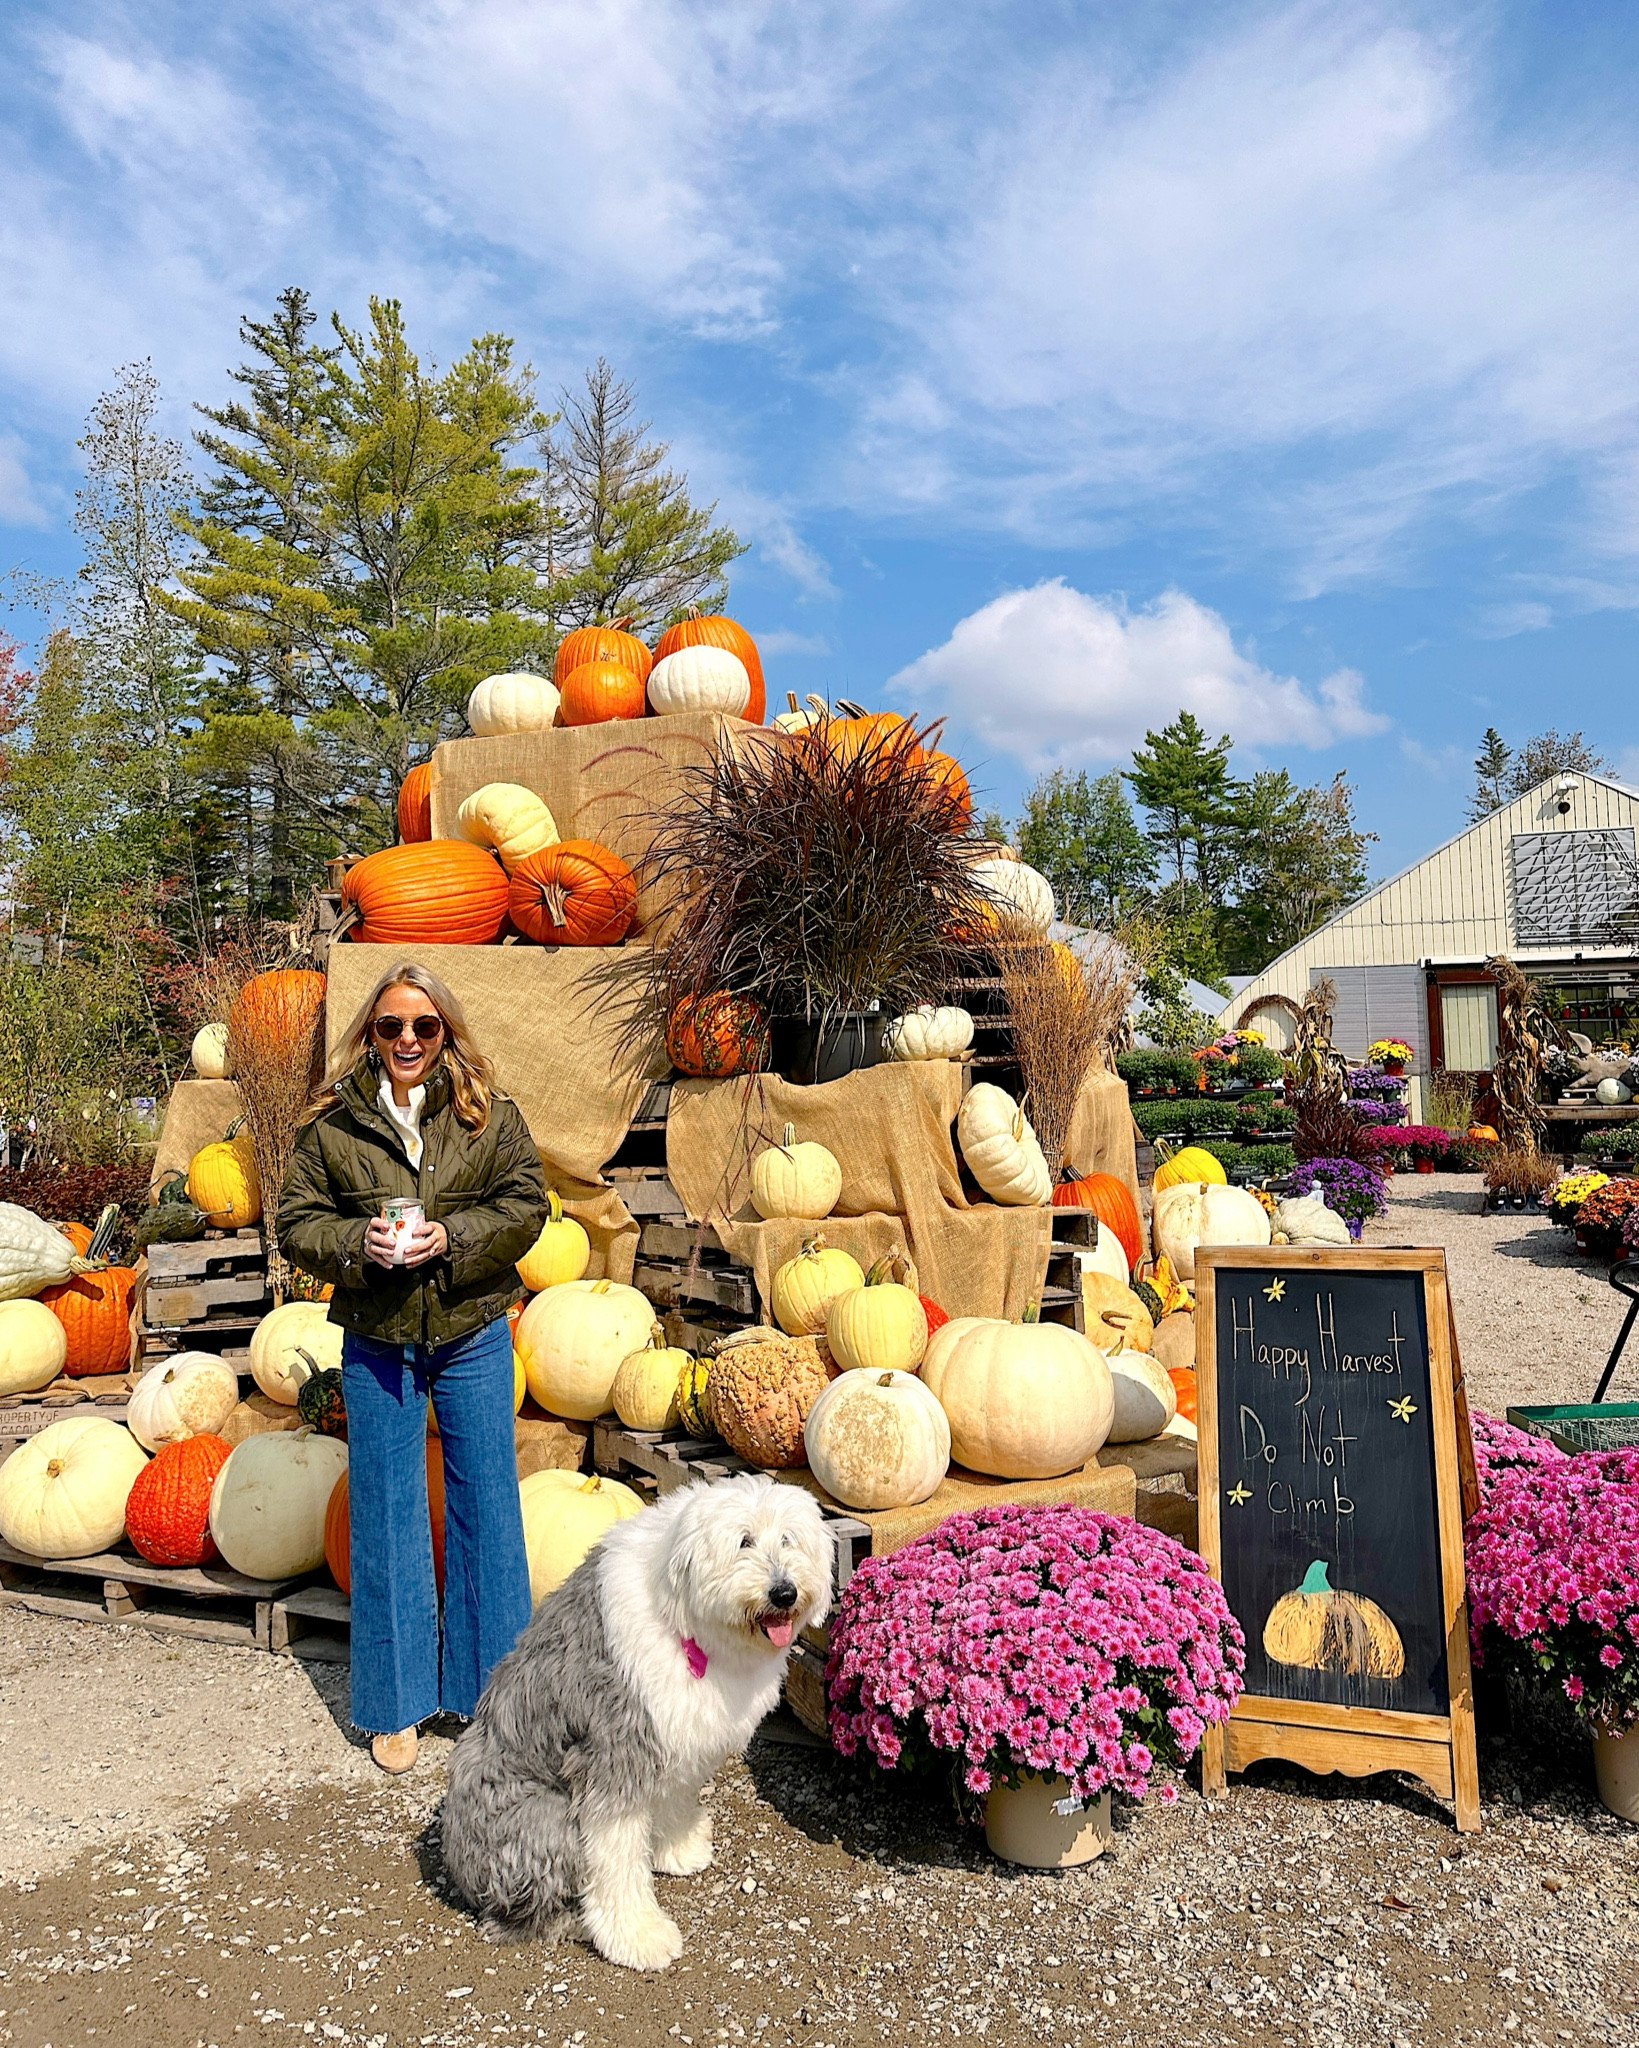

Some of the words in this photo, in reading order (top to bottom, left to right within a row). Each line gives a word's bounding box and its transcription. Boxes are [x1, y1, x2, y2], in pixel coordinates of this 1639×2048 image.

[1231, 1296, 1312, 1406] Happy
[1316, 1292, 1406, 1375] Harvest
[1240, 1404, 1277, 1464] Do
[1302, 1405, 1358, 1467] Not
[1267, 1475, 1355, 1514] Climb
